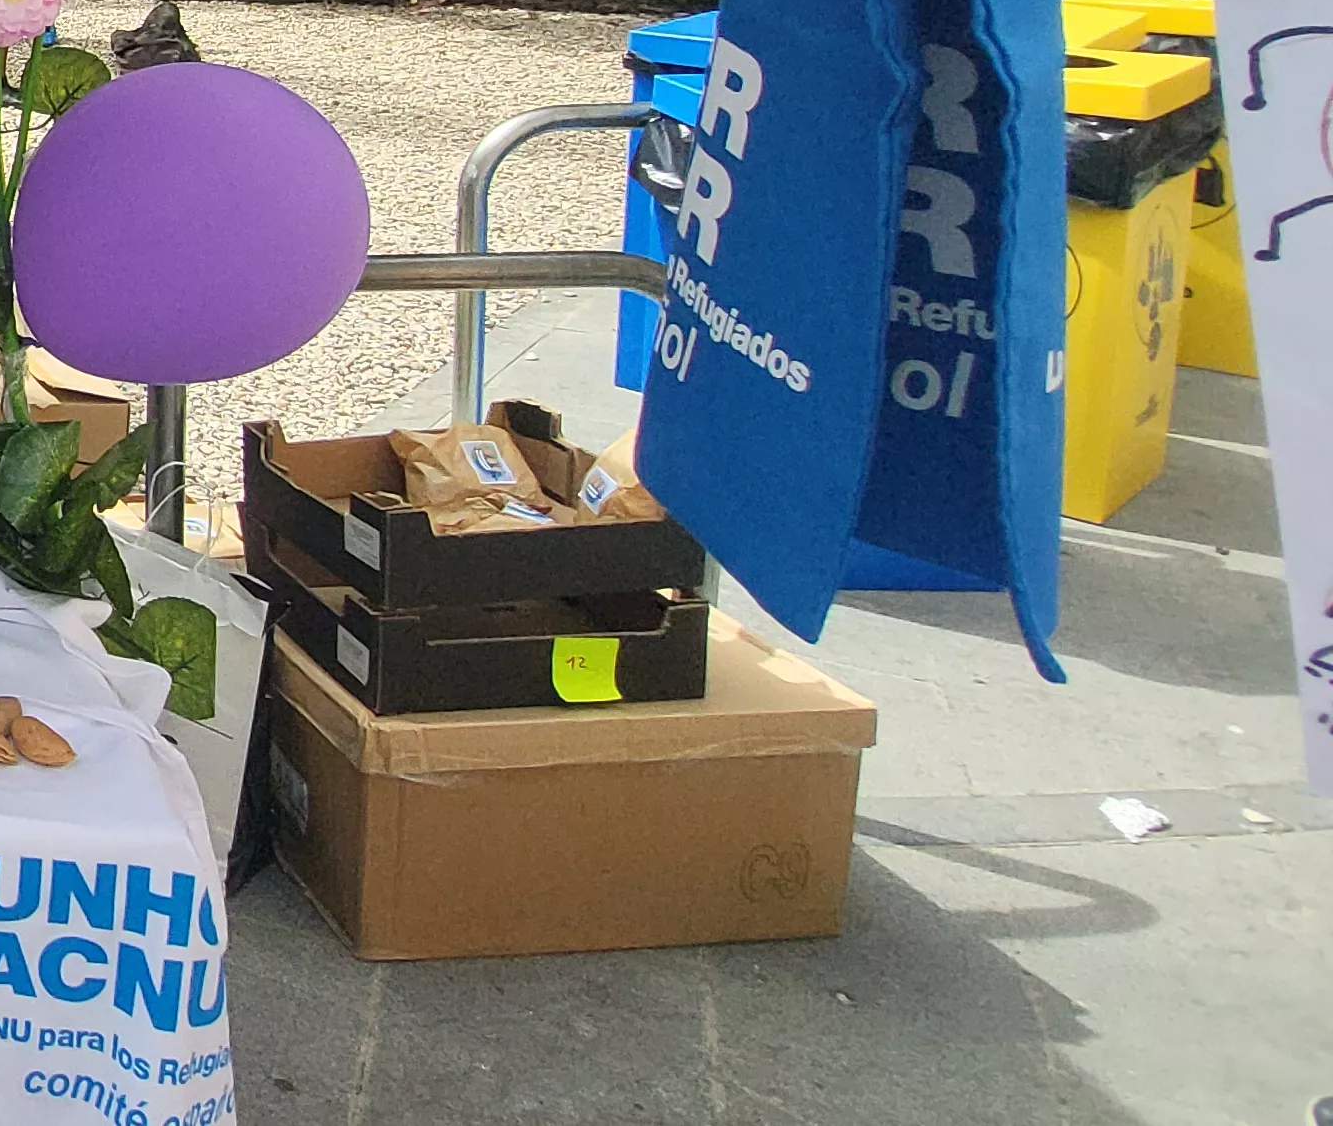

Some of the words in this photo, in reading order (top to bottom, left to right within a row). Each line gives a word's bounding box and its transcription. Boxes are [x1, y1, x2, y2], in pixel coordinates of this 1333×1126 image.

[672, 256, 812, 393] Refugiados
[566, 656, 588, 670] 12
[38, 1027, 105, 1065] para
[112, 1034, 152, 1080] los
